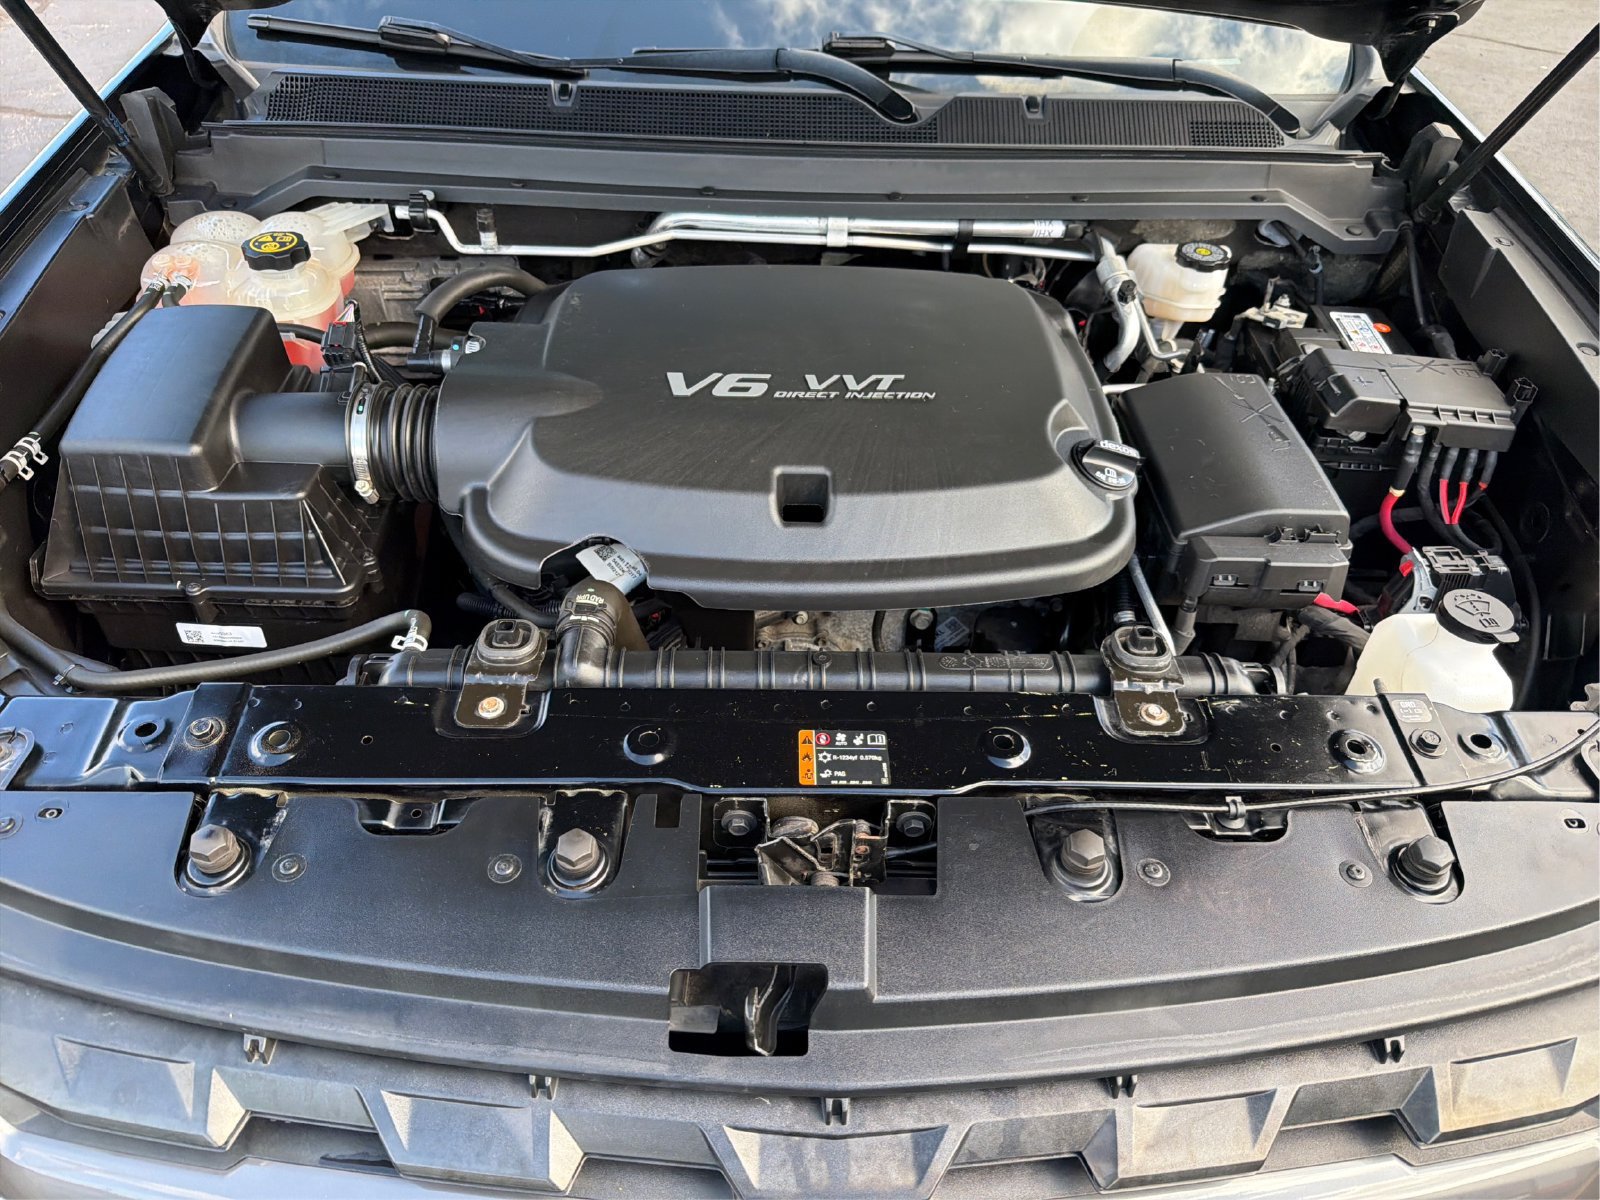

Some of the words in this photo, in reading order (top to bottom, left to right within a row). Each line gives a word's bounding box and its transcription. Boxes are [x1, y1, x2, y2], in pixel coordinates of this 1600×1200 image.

[666, 372, 772, 398] V6
[804, 374, 906, 391] VVT
[773, 391, 840, 399] DIRECT
[845, 391, 936, 400] INJECTION
[590, 594, 604, 604] RAD
